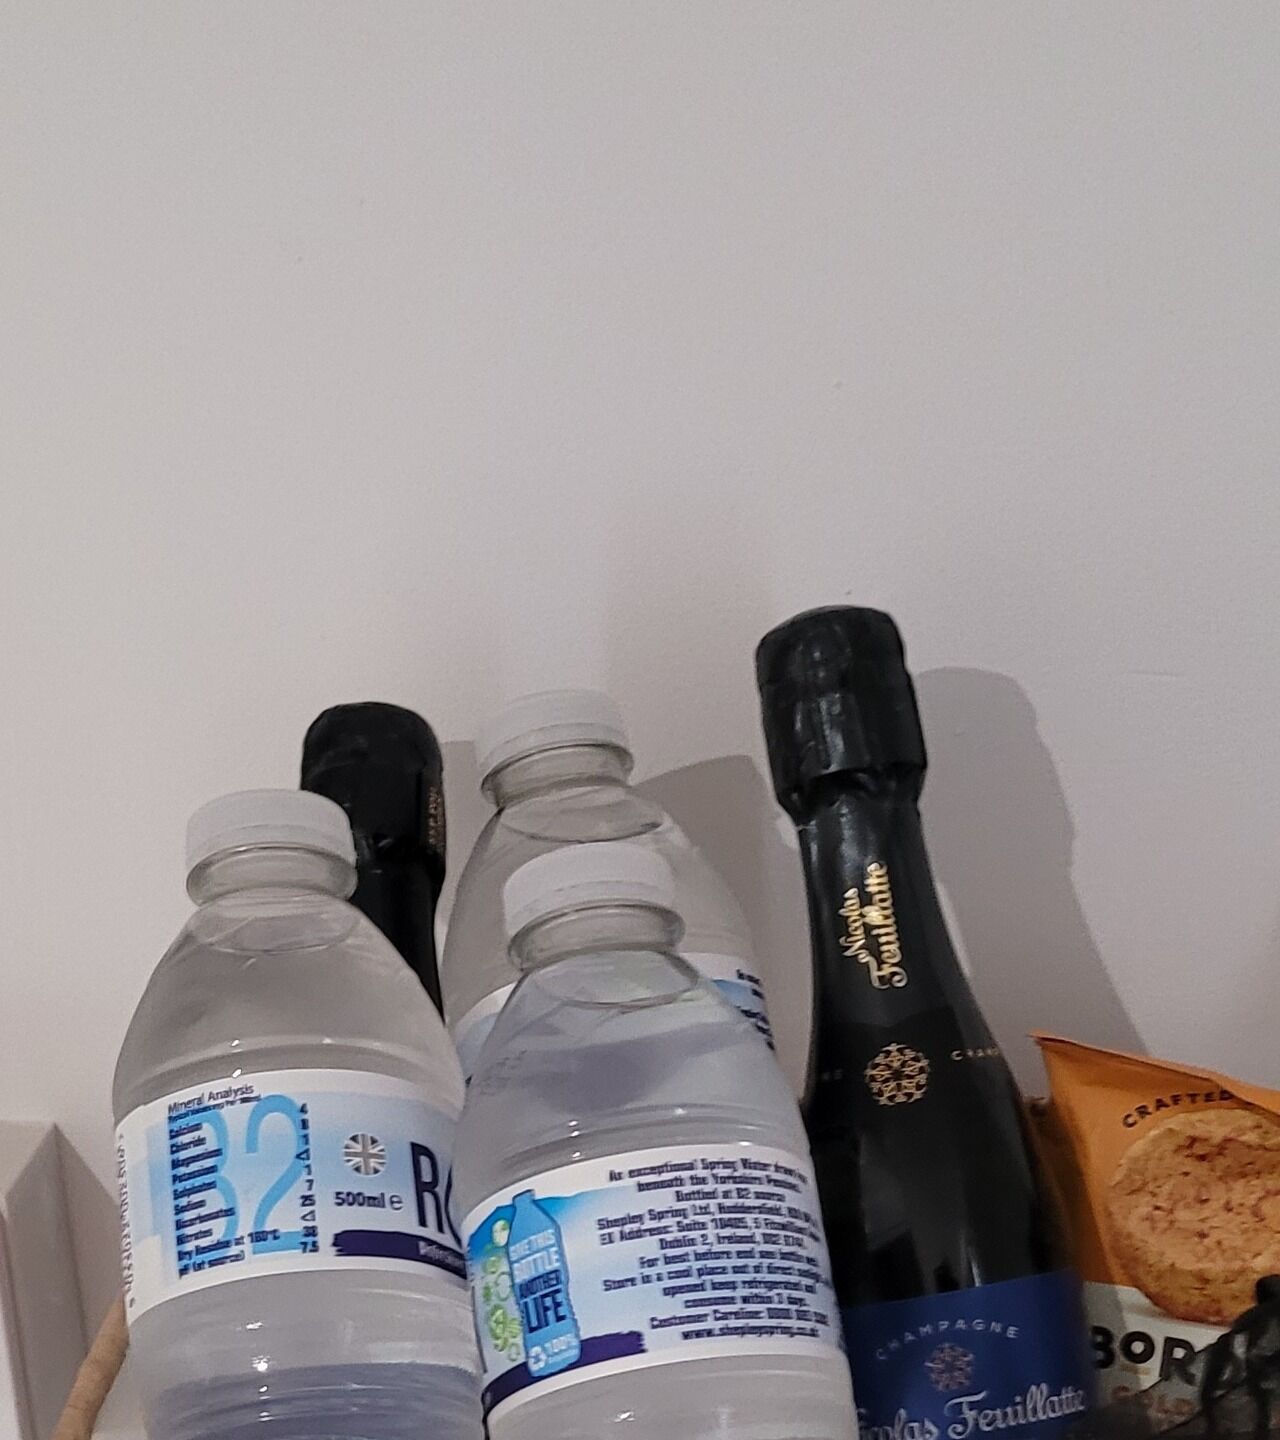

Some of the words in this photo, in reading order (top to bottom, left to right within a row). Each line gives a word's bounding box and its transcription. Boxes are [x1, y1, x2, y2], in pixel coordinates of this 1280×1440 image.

[168, 1093, 204, 1115] Mineral
[208, 1084, 255, 1102] Analysis
[1122, 1089, 1237, 1129] CRAFTED
[701, 1158, 737, 1172] Spring
[689, 1174, 708, 1186] the
[334, 1190, 386, 1209] 500ml
[648, 1207, 688, 1222] Spring
[639, 1256, 659, 1269] For
[603, 1276, 637, 1291] Store
[524, 1289, 567, 1333] LIFE
[875, 1318, 1020, 1361] CHAMPAGNE
